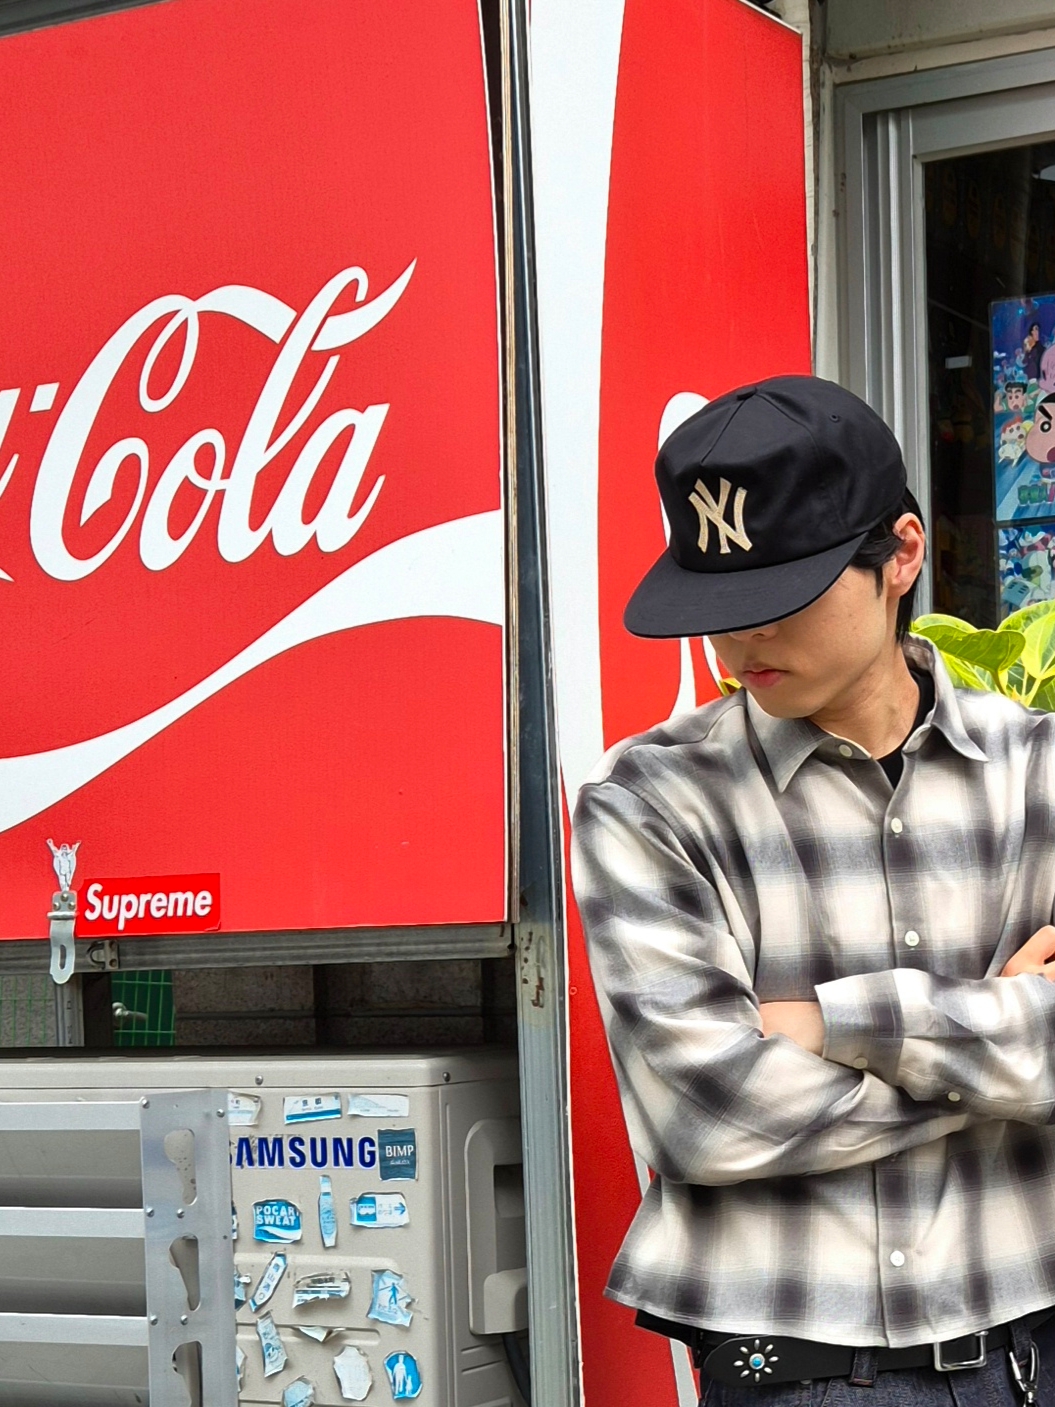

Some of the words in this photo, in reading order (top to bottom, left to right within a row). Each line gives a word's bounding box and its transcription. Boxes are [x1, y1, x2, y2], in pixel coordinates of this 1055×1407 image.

[687, 476, 753, 554] NY
[85, 880, 213, 922] Supreme
[230, 1136, 377, 1169] AMSUNG
[385, 1144, 415, 1158] BIMP
[255, 1214, 297, 1226] SWEAT
